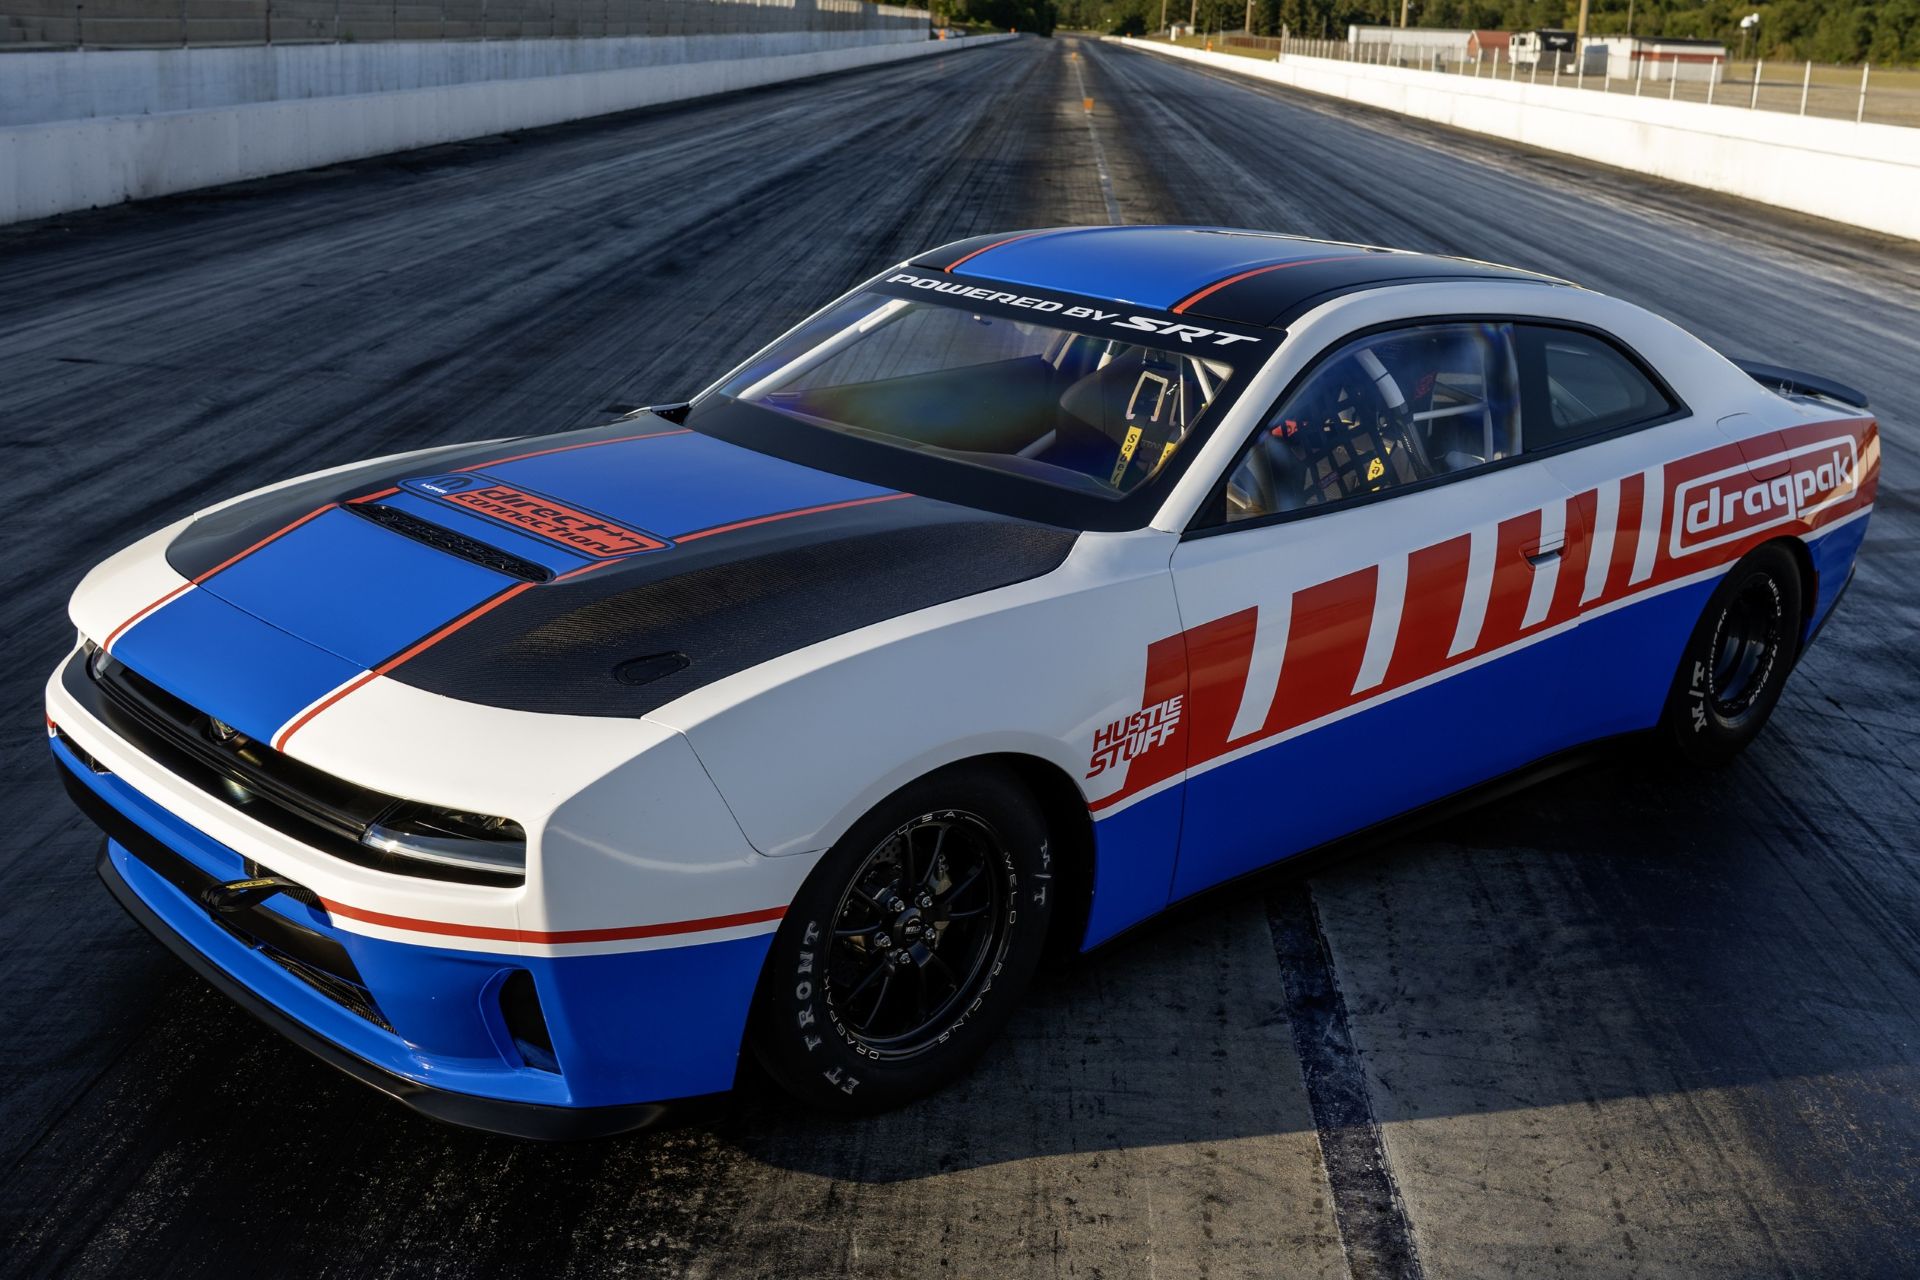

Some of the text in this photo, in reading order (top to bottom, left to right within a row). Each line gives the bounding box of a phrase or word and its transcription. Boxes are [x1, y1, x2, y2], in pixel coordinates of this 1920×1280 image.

[886, 273, 1262, 346] POWERED BY SRT
[1111, 433, 1138, 488] Sabel
[1686, 451, 1853, 534] dragpak
[455, 493, 611, 552] connection
[478, 489, 606, 532] direct
[1085, 717, 1180, 780] STUFF
[1092, 695, 1184, 752] HUSTLE
[1004, 853, 1018, 924] WELD
[795, 920, 861, 1095] ET FRONT
[823, 975, 880, 1060] DRAGPAK
